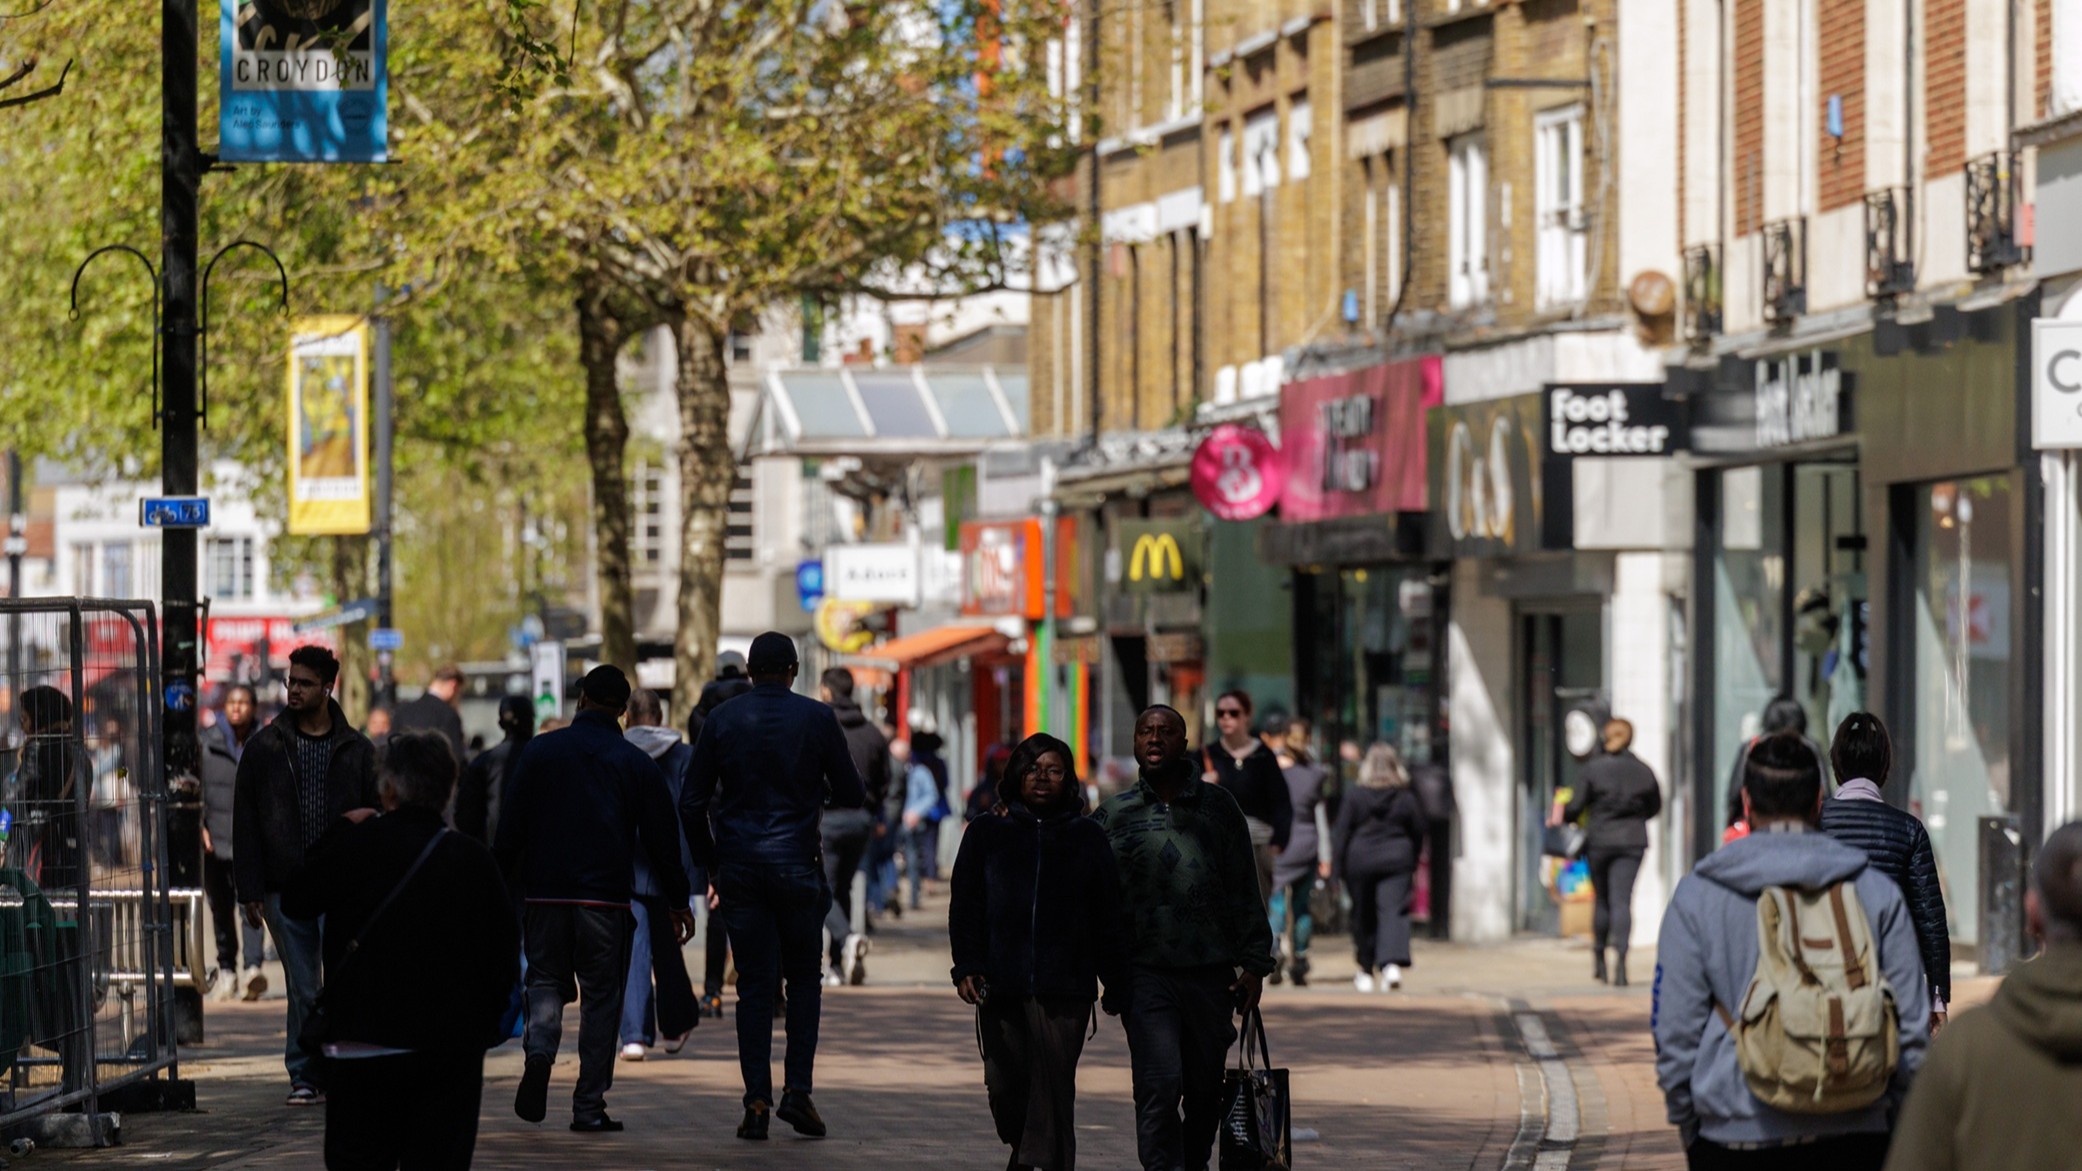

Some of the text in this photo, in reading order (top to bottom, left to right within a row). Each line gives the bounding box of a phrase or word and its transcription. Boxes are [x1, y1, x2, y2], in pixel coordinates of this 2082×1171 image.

[237, 58, 369, 83] CROYDON
[233, 105, 262, 118] Art by
[1551, 388, 1629, 422] Foot
[1551, 420, 1669, 454] Locker
